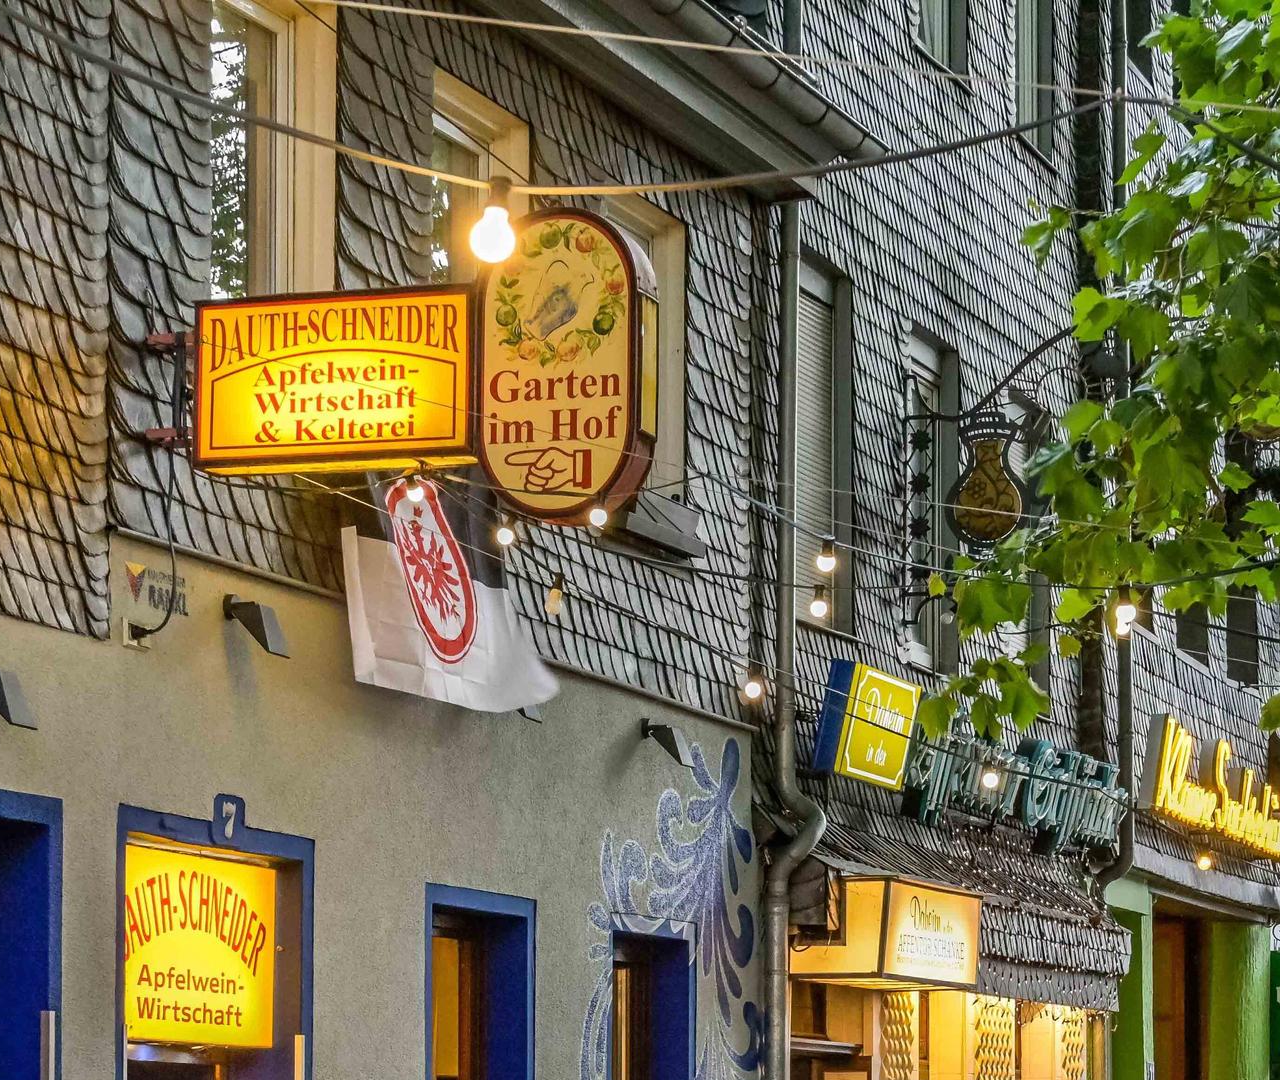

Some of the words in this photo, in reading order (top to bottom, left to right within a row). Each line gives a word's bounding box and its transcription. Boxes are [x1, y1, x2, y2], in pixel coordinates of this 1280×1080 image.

[209, 303, 459, 373] DAUTH-SCHNEIDER
[253, 358, 419, 393] Apfelwein-
[489, 368, 622, 404] Garten
[254, 386, 418, 415] Wirtschaft
[254, 420, 281, 443] &
[294, 415, 416, 442] Kelterei
[488, 414, 535, 446] im
[550, 406, 622, 442] Hof
[222, 801, 237, 839] 7
[137, 963, 245, 995] Apfelwein-
[136, 996, 243, 1028] Wirtschaft
